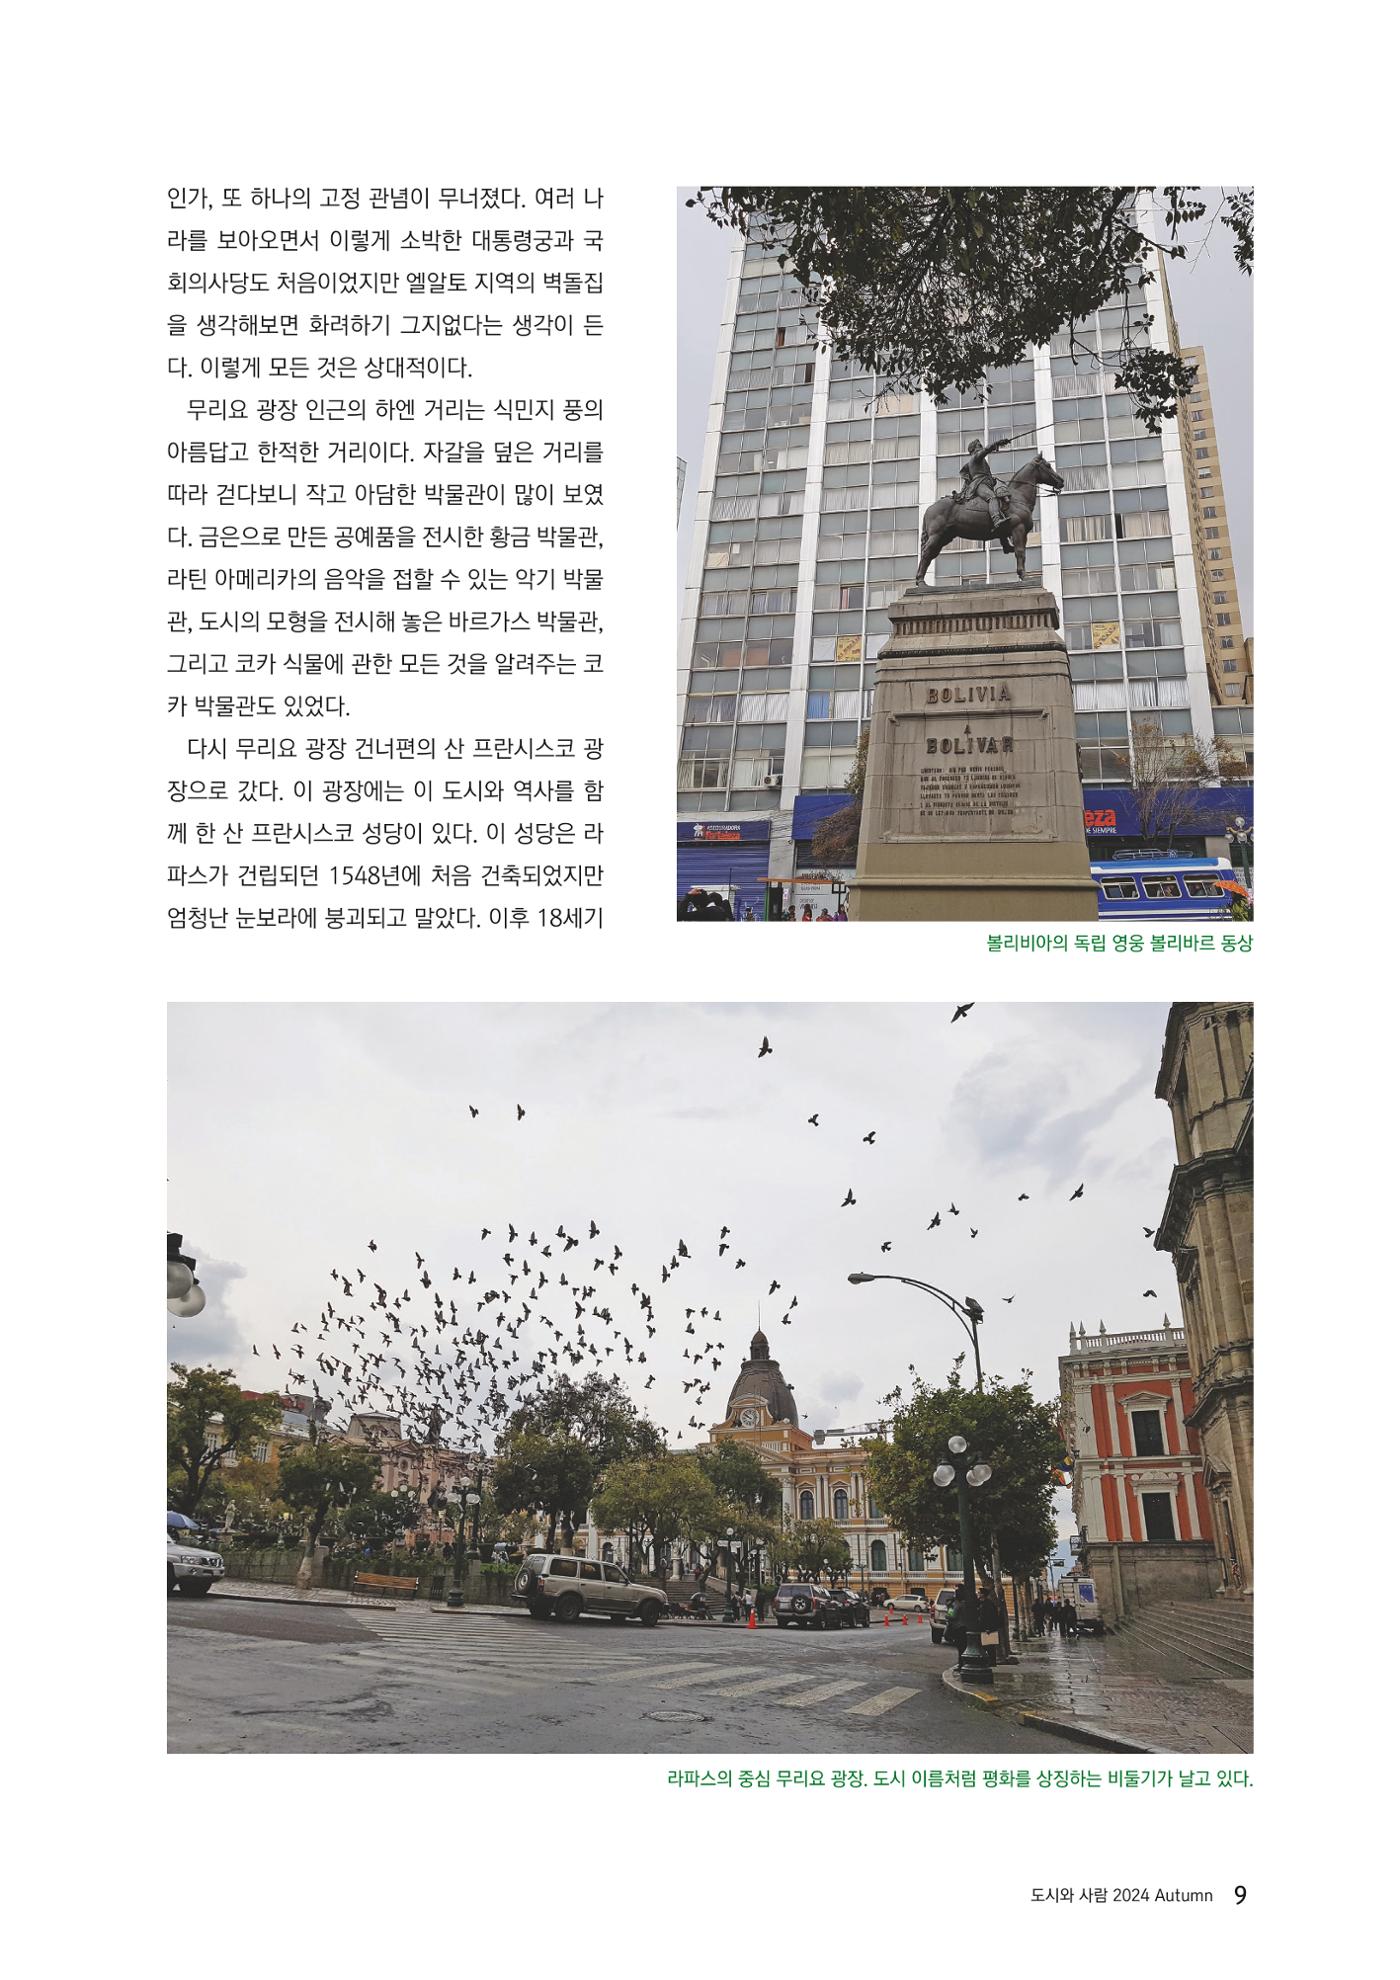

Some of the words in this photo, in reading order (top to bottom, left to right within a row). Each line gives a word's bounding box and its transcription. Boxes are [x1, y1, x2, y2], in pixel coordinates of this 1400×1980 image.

[167, 186, 213, 212] 인가,
[221, 188, 242, 207] 또
[250, 186, 310, 210] 하나의
[319, 186, 360, 210] 고정
[368, 187, 429, 210] 관념이
[438, 186, 526, 210] 무너졌다.
[535, 186, 574, 210] 여러
[584, 186, 605, 210] 나
[167, 229, 208, 252] 라를
[216, 229, 319, 252] 보아오면서
[330, 229, 390, 253] 이렇게
[400, 229, 463, 252] 소박한
[472, 229, 575, 253] 대통령궁과
[583, 229, 604, 253] 국
[167, 271, 270, 295] 회의사당도
[276, 271, 400, 295] 처음이었지만
[406, 271, 468, 295] 엘알토
[474, 271, 535, 295] 지역의
[543, 271, 603, 295] 벽돌집
[167, 313, 188, 337] 을
[196, 314, 299, 337] 생각해보면
[308, 313, 390, 337] 화려하기
[399, 314, 504, 337] 그지없다는
[512, 313, 573, 337] 생각이
[583, 314, 604, 337] 든
[168, 356, 193, 379] 다.
[200, 356, 260, 380] 이렇게
[268, 356, 310, 379] 모든
[317, 356, 358, 379] 것은
[364, 356, 473, 380] 상대적이다.
[186, 398, 249, 422] 무리요
[256, 398, 299, 422] 광장
[305, 398, 366, 422] 인근의
[375, 398, 415, 422] 하엔
[424, 398, 486, 422] 거리는
[493, 398, 554, 422] 식민지
[562, 398, 603, 422] 풍의
[167, 440, 249, 464] 아름답고
[257, 440, 320, 464] 한적한
[327, 440, 415, 464] 거리이다.
[423, 440, 485, 464] 자갈을
[494, 440, 535, 464] 덮은
[543, 441, 604, 464] 거리를
[168, 483, 209, 506] 따라
[216, 483, 296, 507] 걷다보니
[305, 483, 347, 507] 작고
[355, 483, 417, 506] 아담한
[424, 483, 505, 507] 박물관이
[515, 483, 554, 507] 많이
[562, 483, 604, 506] 보였
[167, 525, 193, 549] 다.
[199, 525, 282, 549] 금은으로
[287, 525, 329, 549] 만든
[333, 525, 417, 549] 공예품을
[422, 525, 485, 549] 전시한
[489, 525, 531, 549] 황금
[537, 525, 604, 550] 박물관,
[167, 568, 207, 591] 라틴
[215, 568, 316, 591] 아메리카의
[323, 568, 386, 591] 음악을
[392, 567, 435, 591] 접할
[440, 568, 461, 591] 수
[467, 568, 509, 591] 있는
[515, 568, 555, 591] 악기
[563, 568, 604, 591] 박물
[167, 610, 193, 635] 관,
[198, 610, 260, 633] 도시의
[266, 610, 329, 634] 모형을
[334, 610, 395, 633] 전시해
[401, 610, 443, 634] 놓은
[449, 610, 531, 633] 바르가스
[537, 610, 604, 635] 박물관,
[166, 652, 229, 676] 그리고
[234, 652, 277, 676] 코카
[282, 652, 344, 676] 식물에
[351, 652, 393, 675] 관한
[399, 653, 441, 675] 모든
[447, 652, 488, 676] 것을
[495, 652, 577, 676] 알려주는
[583, 653, 604, 673] 코
[167, 695, 188, 718] 카
[195, 695, 277, 718] 박물관도
[283, 695, 350, 718] 있었다.
[926, 685, 1012, 705] BOLIVIA
[963, 724, 972, 735] A
[187, 737, 227, 760] 다시
[235, 737, 298, 760] 무리요
[305, 737, 348, 761] 광장
[355, 737, 436, 761] 건너편의
[443, 737, 465, 760] 산
[472, 737, 576, 760] 프란시스코
[583, 737, 605, 761] 광
[926, 736, 1014, 755] BOLIVAR
[167, 779, 229, 803] 장으로
[237, 779, 284, 803] 갔다.
[293, 779, 312, 803] 이
[322, 779, 405, 803] 광장에는
[414, 779, 432, 803] 이
[442, 779, 505, 803] 도시와
[513, 779, 575, 803] 역사를
[584, 779, 605, 803] 함
[167, 822, 187, 845] 께
[195, 822, 217, 845] 한
[222, 822, 244, 845] 산
[251, 822, 355, 845] 프란시스코
[361, 822, 422, 846] 성당이
[432, 822, 478, 845] 있다.
[486, 822, 505, 845] 이
[514, 822, 576, 846] 성당은
[584, 822, 605, 845] 라
[167, 864, 229, 887] 파스가
[238, 864, 319, 887] 건립되던
[330, 864, 421, 888] 1548년에
[431, 864, 472, 887] 처음
[481, 864, 605, 888] 건축되었지만
[167, 906, 229, 930] 엄청난
[235, 906, 317, 930] 눈보라에
[324, 906, 407, 930] 붕괴되고
[415, 906, 481, 930] 말았다.
[489, 907, 530, 930] 이후
[538, 906, 603, 930] 18세기
[1030, 1887, 1075, 1904] 도시와
[1078, 1887, 1109, 1904] 사람
[1112, 1887, 1150, 1903] 2024
[1154, 1888, 1213, 1903] Autumn
[1234, 1884, 1247, 1906] 9
